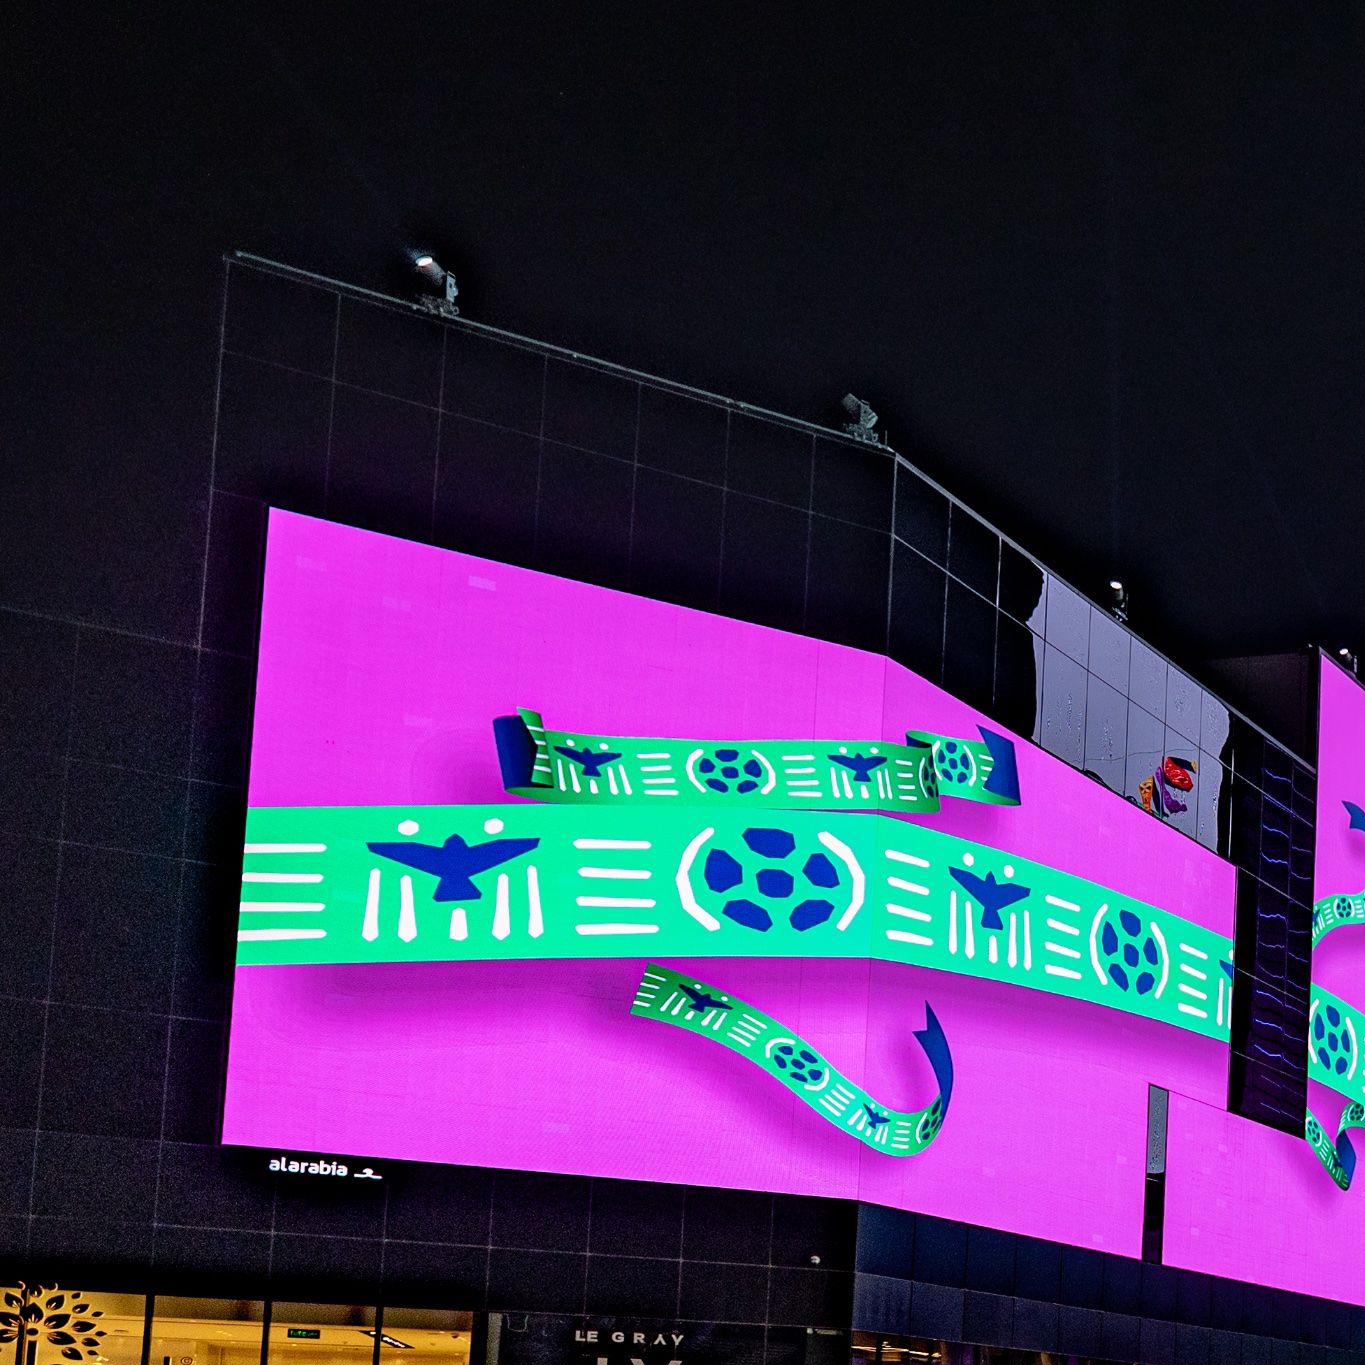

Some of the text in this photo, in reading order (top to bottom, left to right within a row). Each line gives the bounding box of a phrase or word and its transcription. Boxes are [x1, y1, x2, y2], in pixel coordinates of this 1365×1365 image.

[268, 1156, 349, 1177] alarabia
[574, 1330, 685, 1346] LE GRAY
